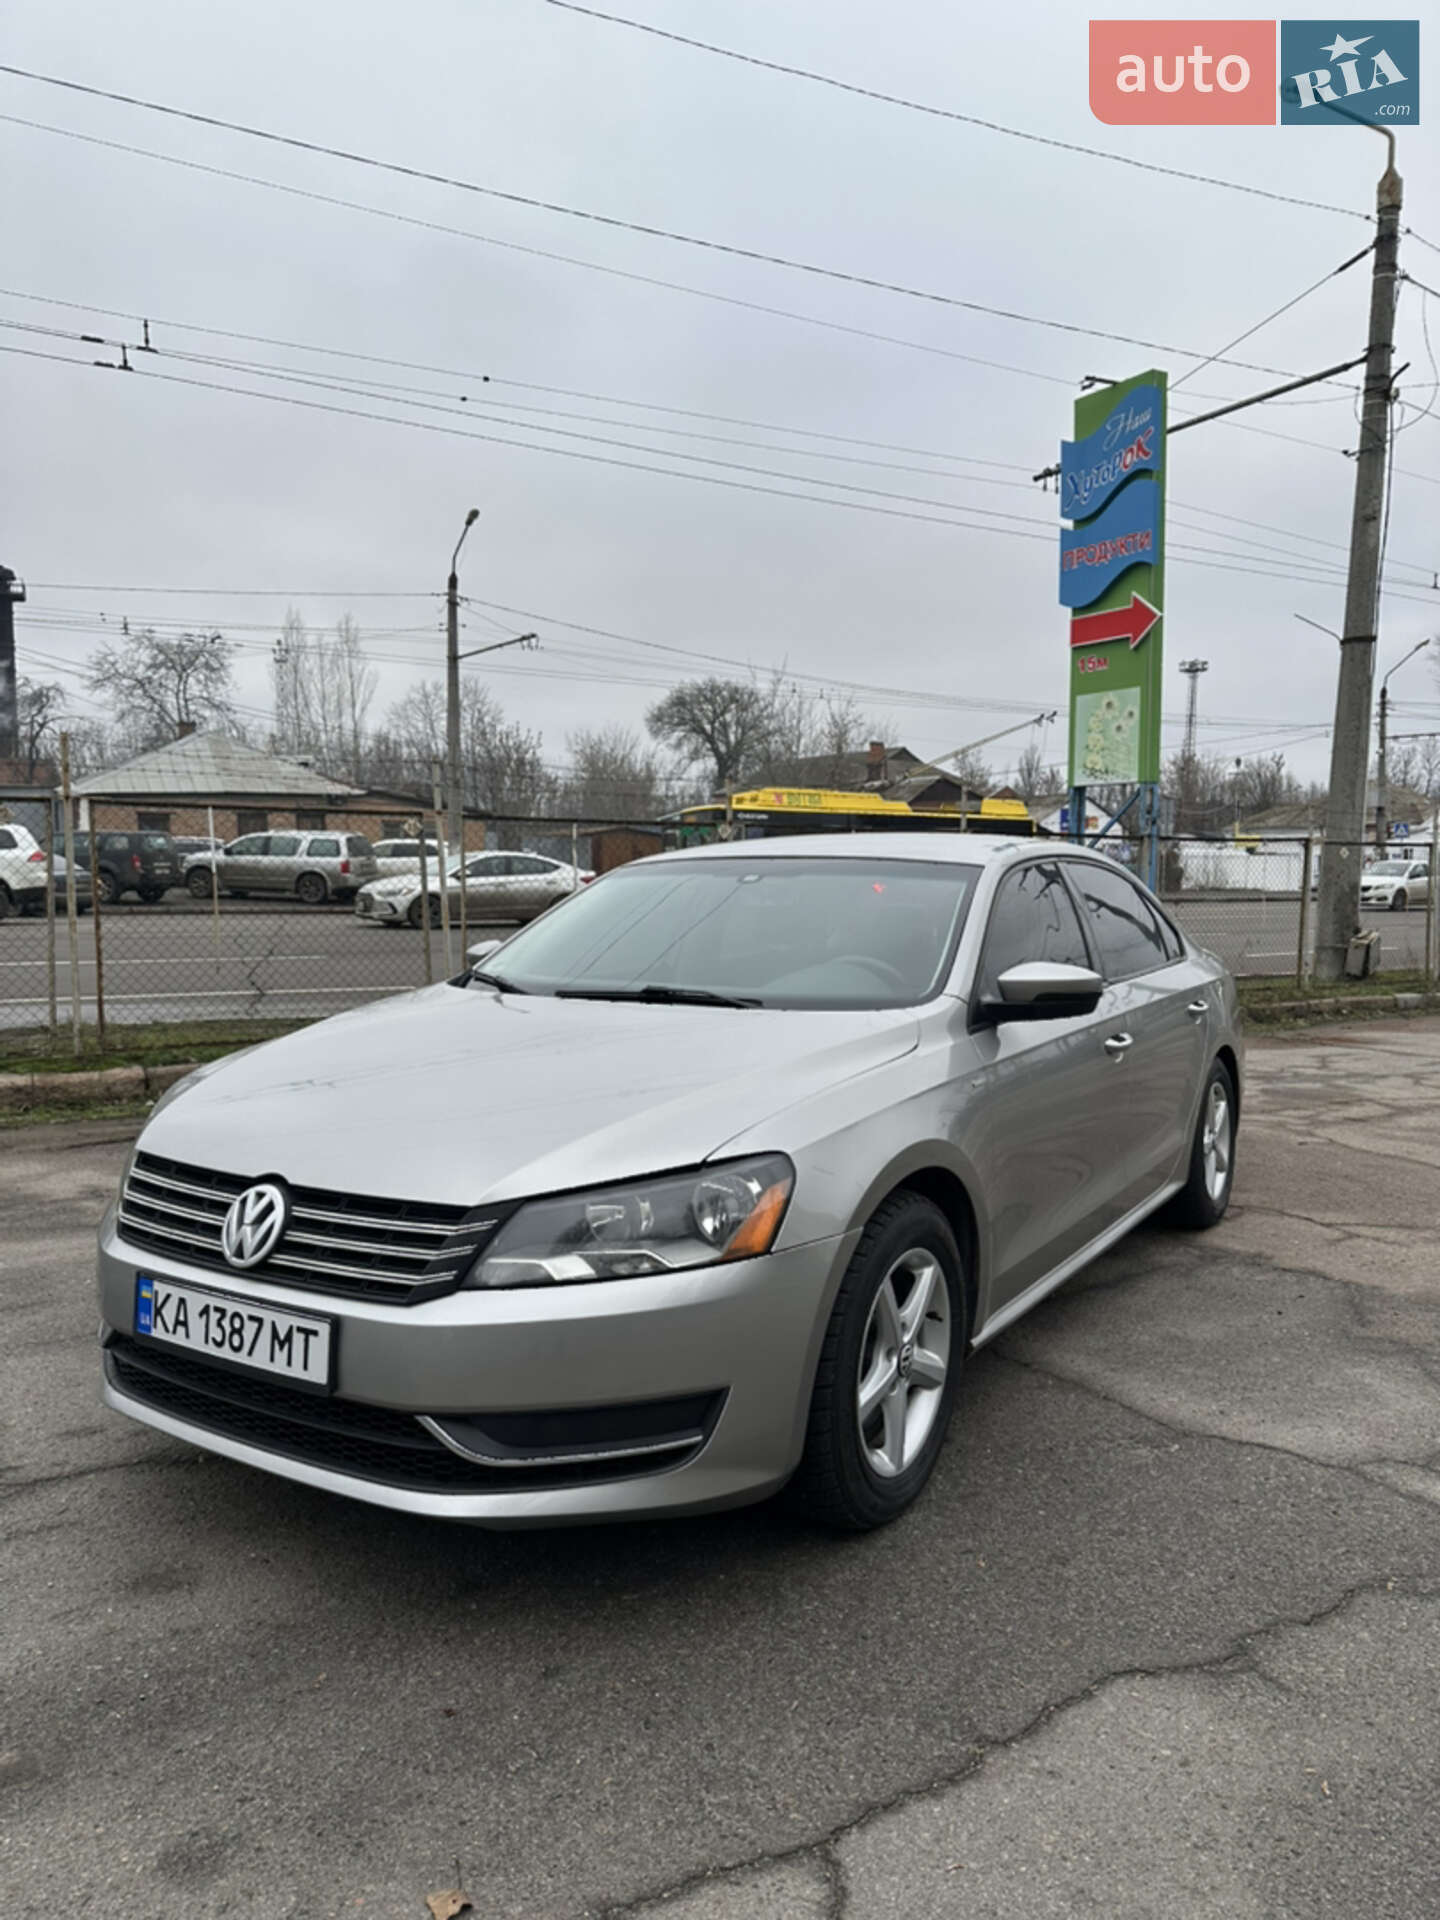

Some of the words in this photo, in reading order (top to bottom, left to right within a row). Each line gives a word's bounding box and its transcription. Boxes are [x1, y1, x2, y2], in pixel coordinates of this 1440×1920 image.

[1063, 530, 1152, 571] ПРОДУКТИ
[153, 1289, 191, 1340] KA
[199, 1303, 265, 1358] 1387
[270, 1320, 320, 1372] MT
